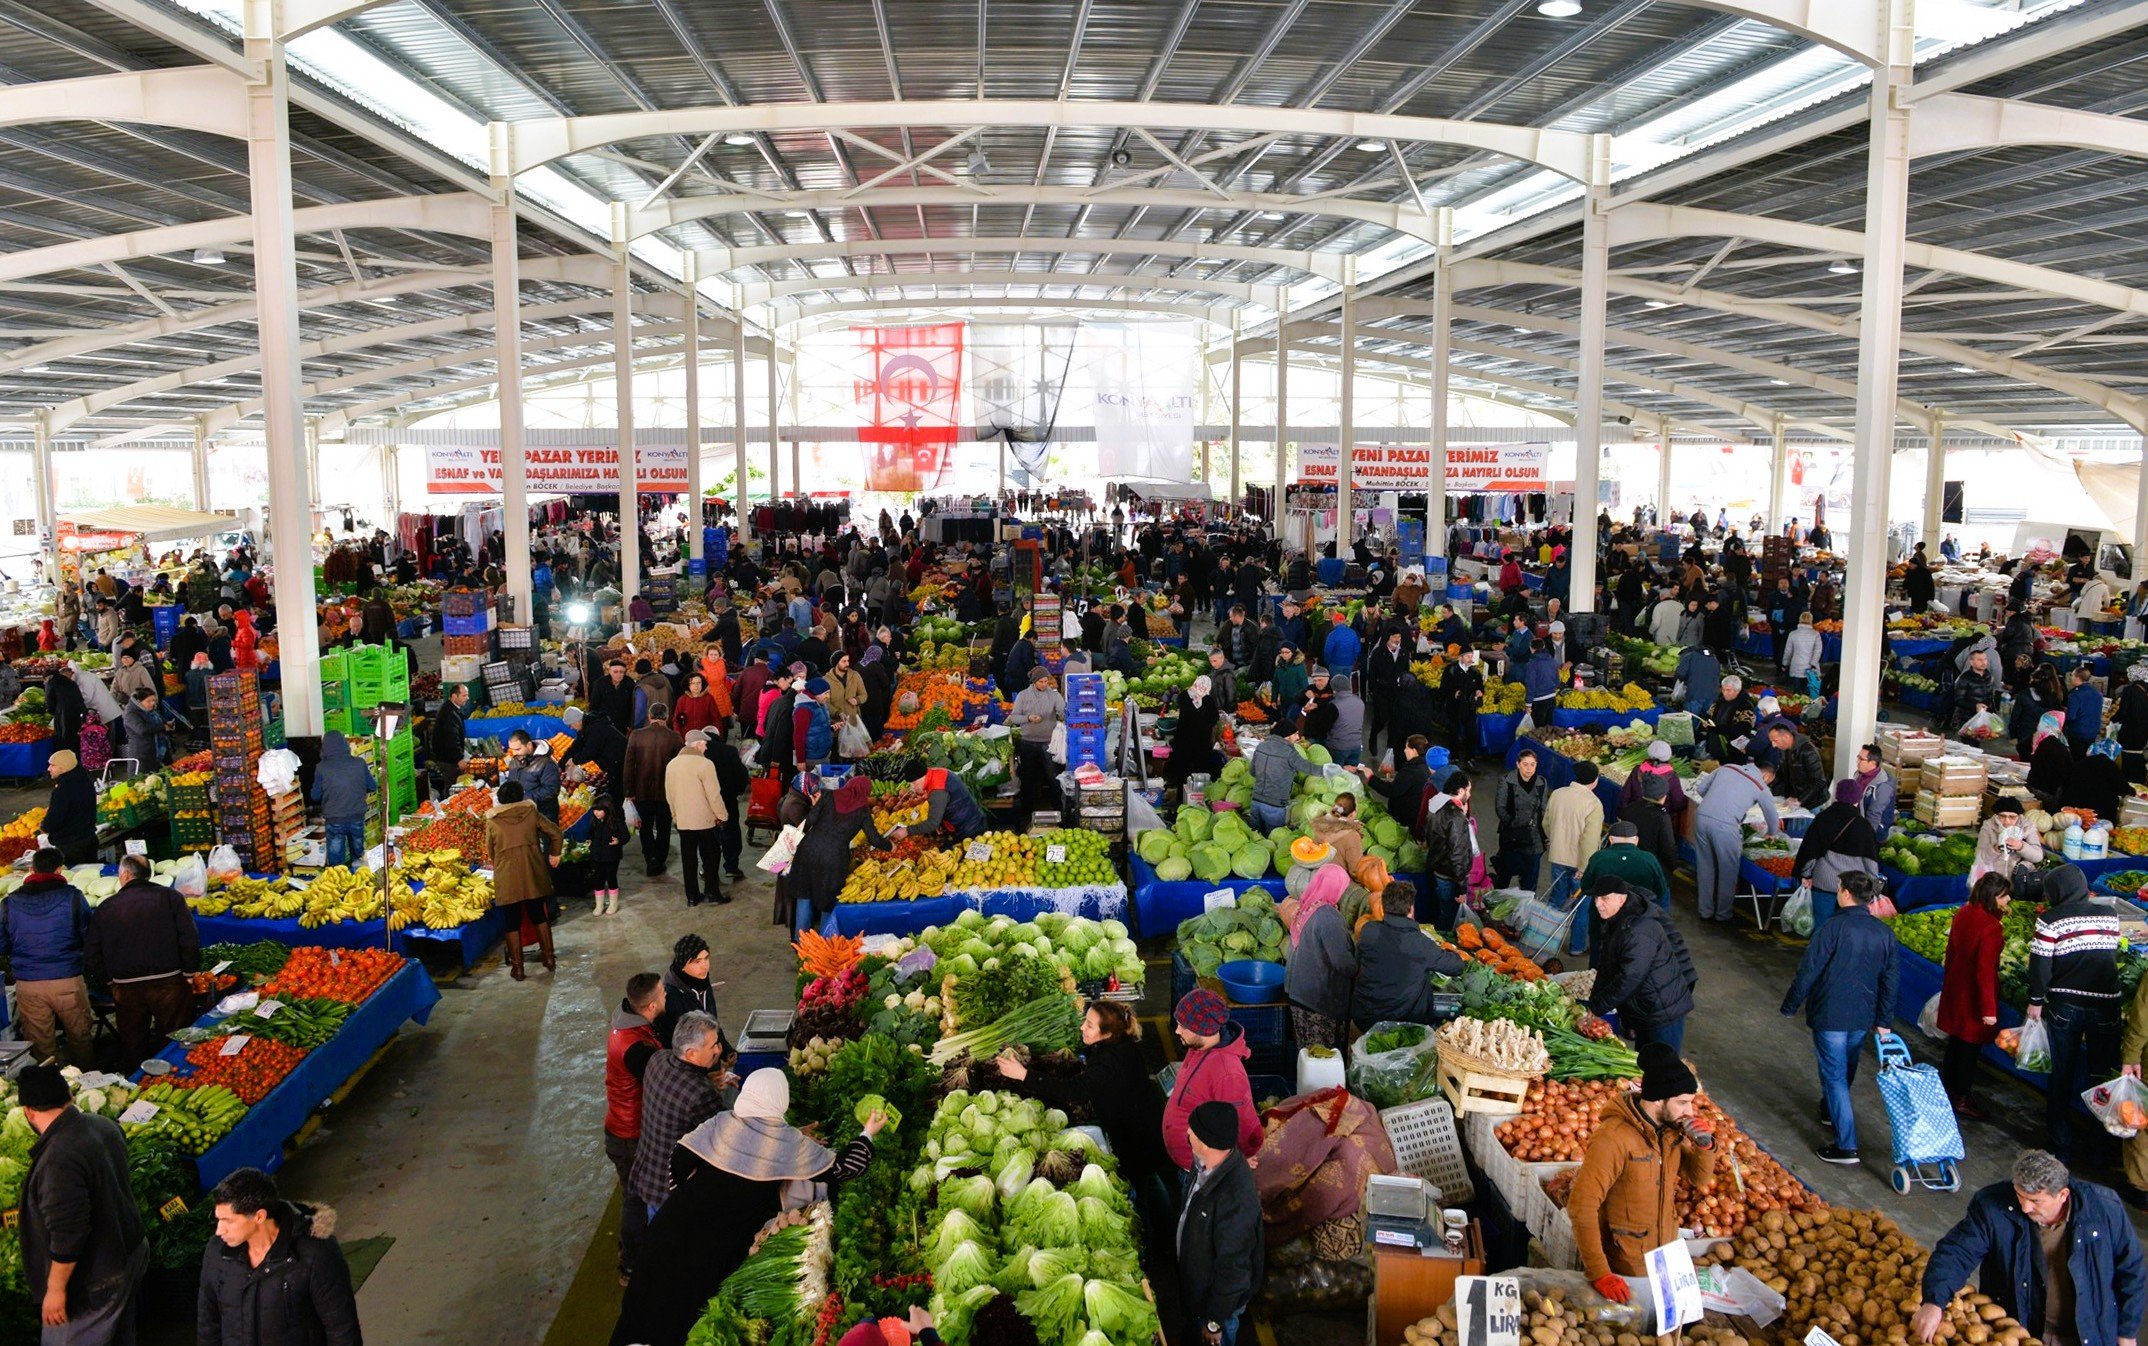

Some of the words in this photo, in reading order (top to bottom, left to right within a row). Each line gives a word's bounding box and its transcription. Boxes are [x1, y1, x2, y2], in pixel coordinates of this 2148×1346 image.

[480, 450, 502, 463] YE
[1446, 448, 1499, 463] ERİMİZ
[435, 468, 469, 479] ESNAF
[472, 470, 485, 479] ve
[488, 468, 600, 482] VADAŞLARIMIZA
[603, 468, 646, 479] HALI
[650, 468, 687, 479] OLSUN
[1305, 465, 1337, 476] ESNAF
[1462, 467, 1501, 478] HAYIRLI
[1505, 467, 1539, 478] OLSUN
[1654, 1249, 1677, 1331] 1
[1466, 1279, 1487, 1346] 1
